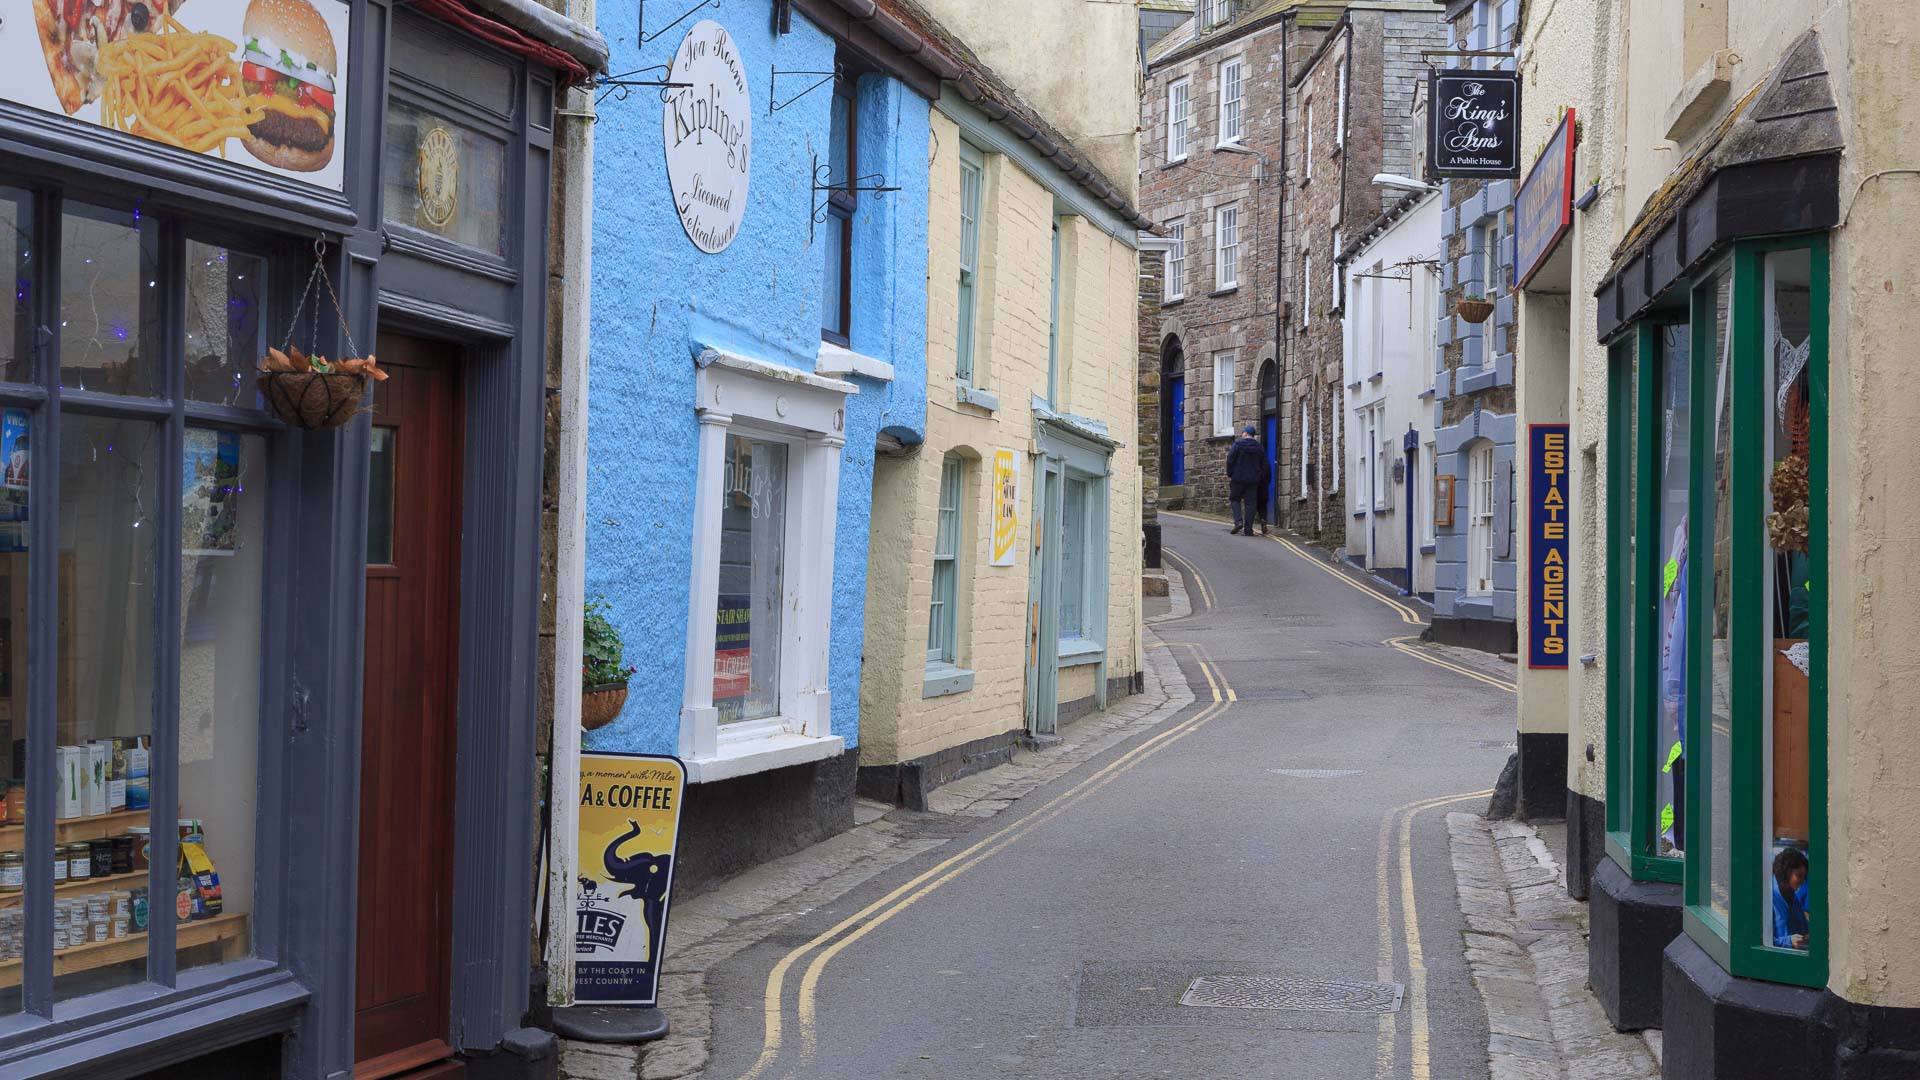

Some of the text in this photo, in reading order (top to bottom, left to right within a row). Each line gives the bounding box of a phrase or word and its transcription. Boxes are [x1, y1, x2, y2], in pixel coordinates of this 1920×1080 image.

[684, 29, 744, 94] Tea Room
[1461, 81, 1486, 97] The
[1444, 97, 1510, 129] King's
[669, 83, 748, 173] Kipling's
[1443, 121, 1503, 152] Arms
[1457, 157, 1479, 165] Public
[1480, 157, 1502, 165] House
[679, 191, 736, 250] Delicatessen
[1543, 433, 1564, 655] ESTATE AGENTS
[717, 609, 735, 624] STAIR
[595, 770, 630, 779] moment
[630, 769, 649, 780] with
[649, 769, 676, 782] Miles
[579, 783, 673, 810] A & COFFEE
[576, 914, 620, 938] ILES
[578, 967, 646, 975] BY THE COAST IN
[595, 977, 634, 985] COUNTRY
